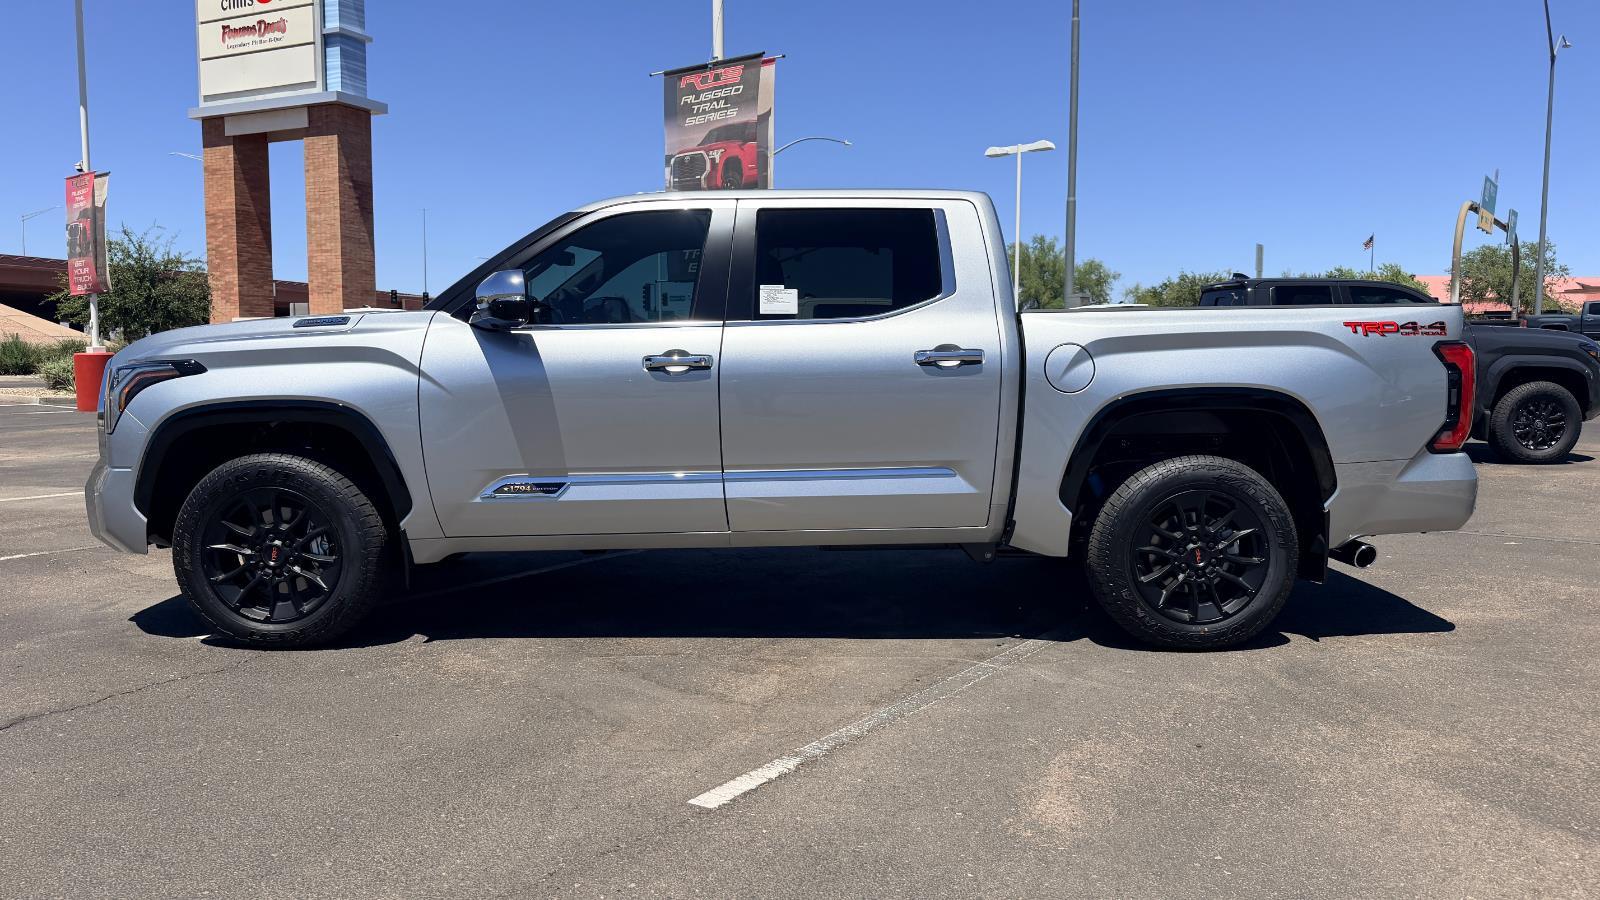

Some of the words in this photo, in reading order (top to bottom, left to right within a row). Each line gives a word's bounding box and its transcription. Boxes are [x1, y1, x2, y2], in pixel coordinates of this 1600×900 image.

[680, 65, 744, 91] RTS
[681, 85, 744, 105] RUGGED
[692, 99, 731, 114] TRAIL
[684, 108, 739, 126] SERIES
[1343, 321, 1400, 337] TRD
